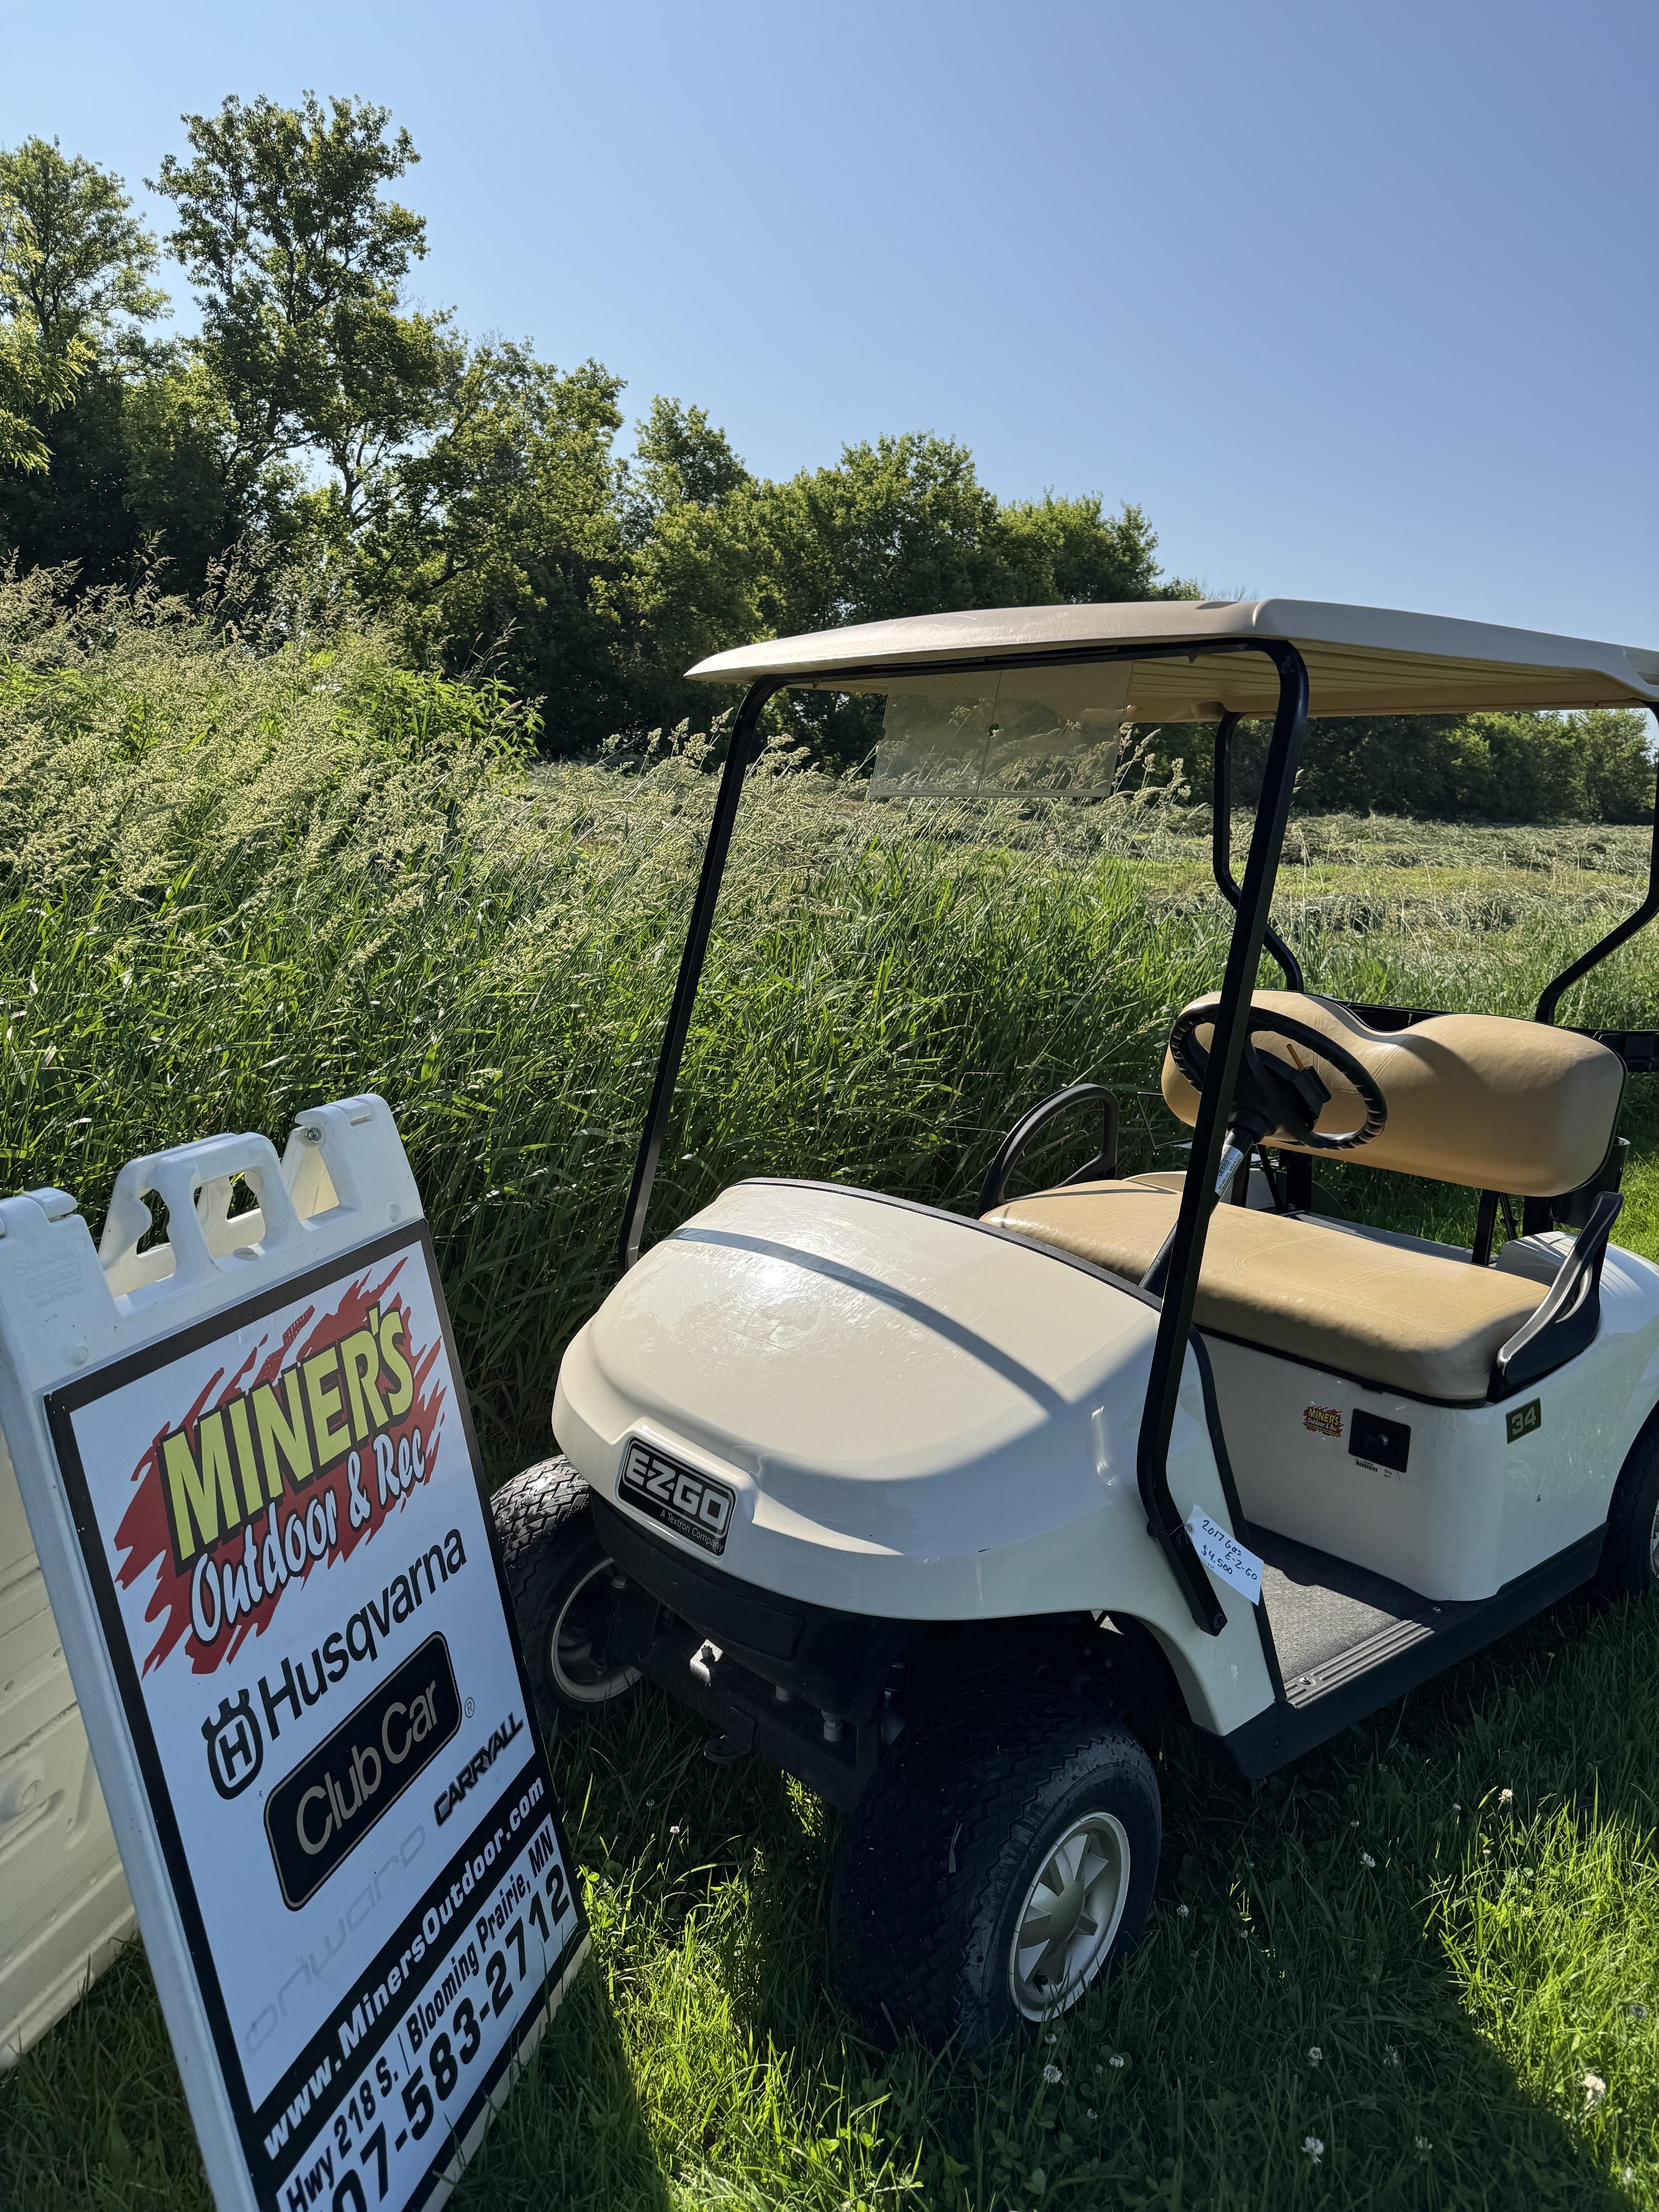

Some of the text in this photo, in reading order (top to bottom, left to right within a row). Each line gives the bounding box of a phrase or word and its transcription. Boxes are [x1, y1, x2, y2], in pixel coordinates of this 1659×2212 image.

[164, 1308, 414, 1560] MINER'S
[626, 1448, 729, 1530] EZGO
[1308, 1408, 1339, 1425] MINER'S
[1511, 1406, 1536, 1435] 34
[191, 1428, 425, 1642] Outdoor & Rec
[660, 1510, 724, 1553] A Textron Company
[1202, 1520, 1242, 1556] 2017 Gas
[257, 1528, 467, 1741] Husqvarna
[296, 1744, 382, 1855] Club
[381, 1680, 438, 1764] Car
[433, 1712, 524, 1828] CARRYALL
[263, 1776, 544, 2161] www.MinersOutdoor.com
[286, 1824, 554, 2212] Hwy 218 S. Blooming Prairie, MN
[319, 1864, 570, 2212] 07-583-2712
